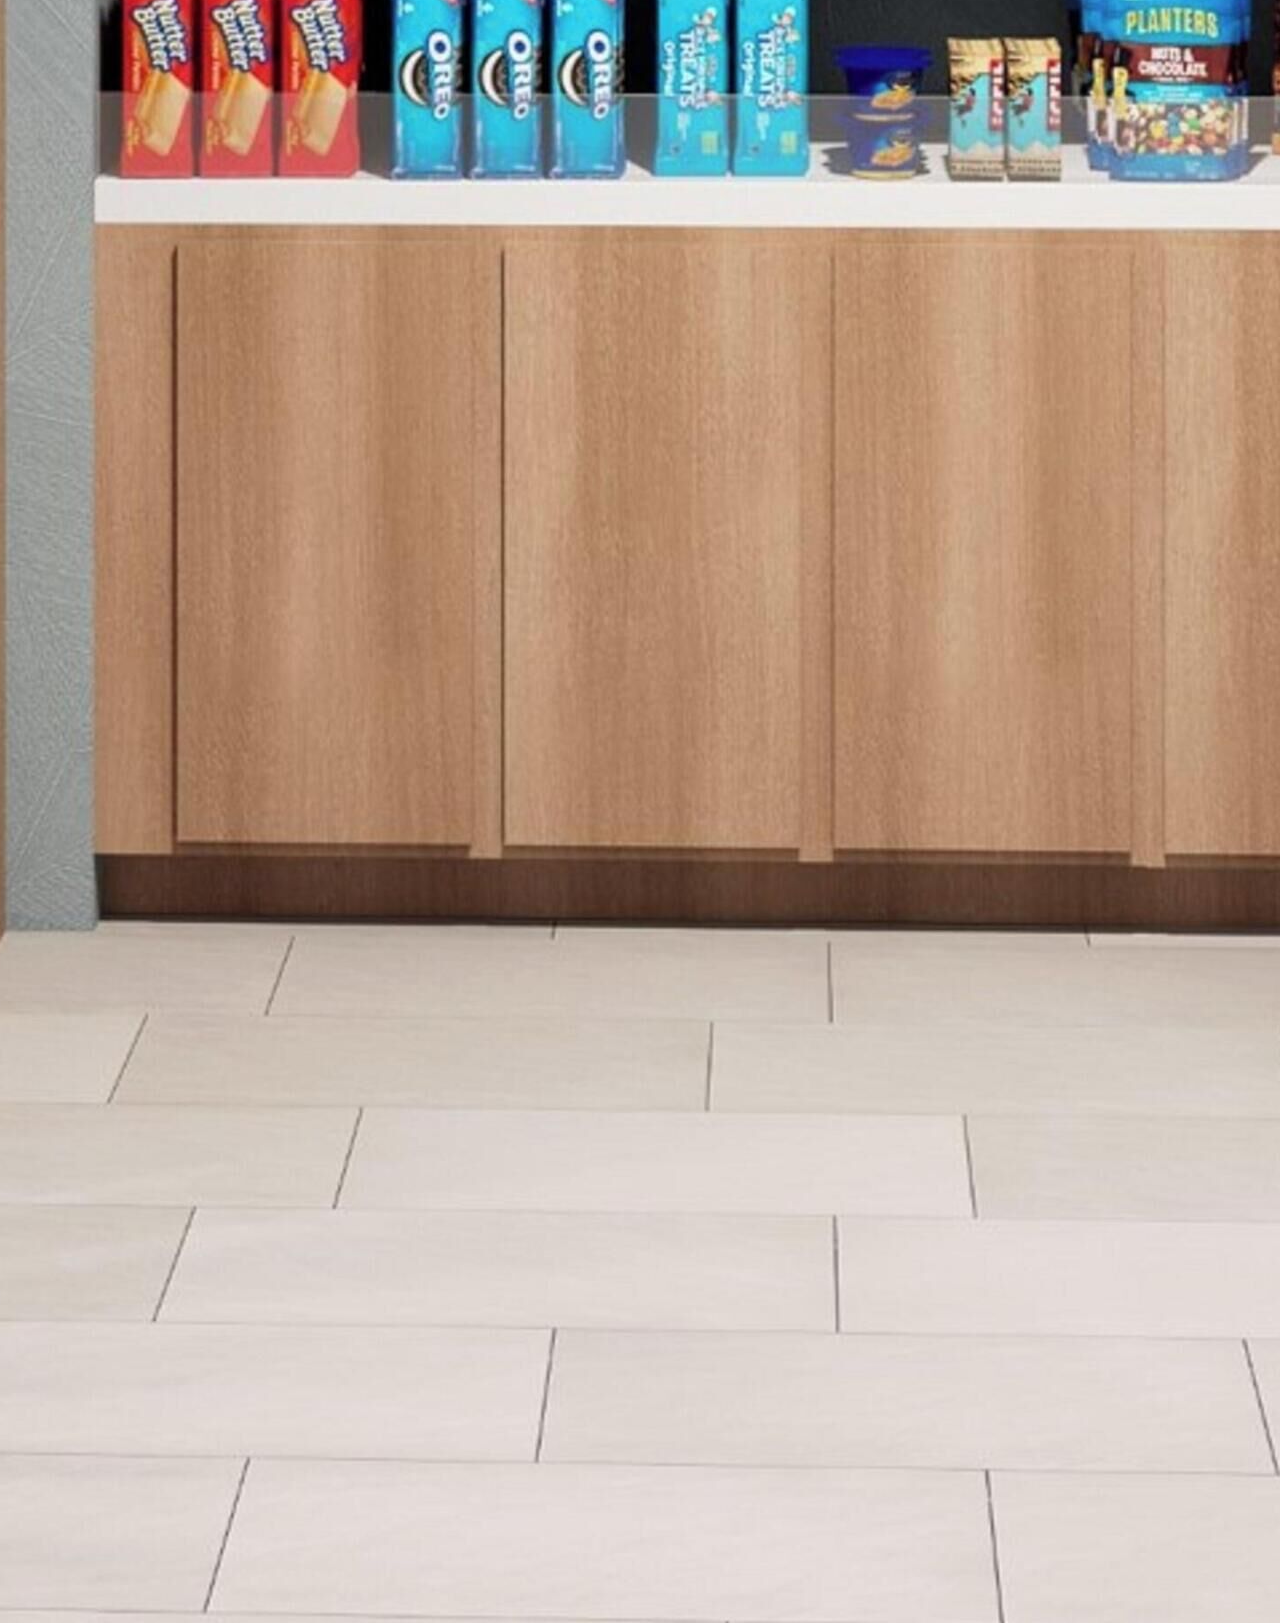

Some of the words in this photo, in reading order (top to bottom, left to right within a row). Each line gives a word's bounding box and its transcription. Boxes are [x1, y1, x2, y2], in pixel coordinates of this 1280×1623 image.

[132, 6, 170, 71] Butter
[212, 6, 250, 71] Butter
[291, 6, 329, 71] Butter
[1126, 7, 1219, 38] PLANTERS
[428, 30, 452, 120] OREO
[507, 30, 532, 120] OREO
[587, 30, 611, 120] OREO
[679, 32, 697, 108] TREATS
[758, 32, 775, 108] TREATS
